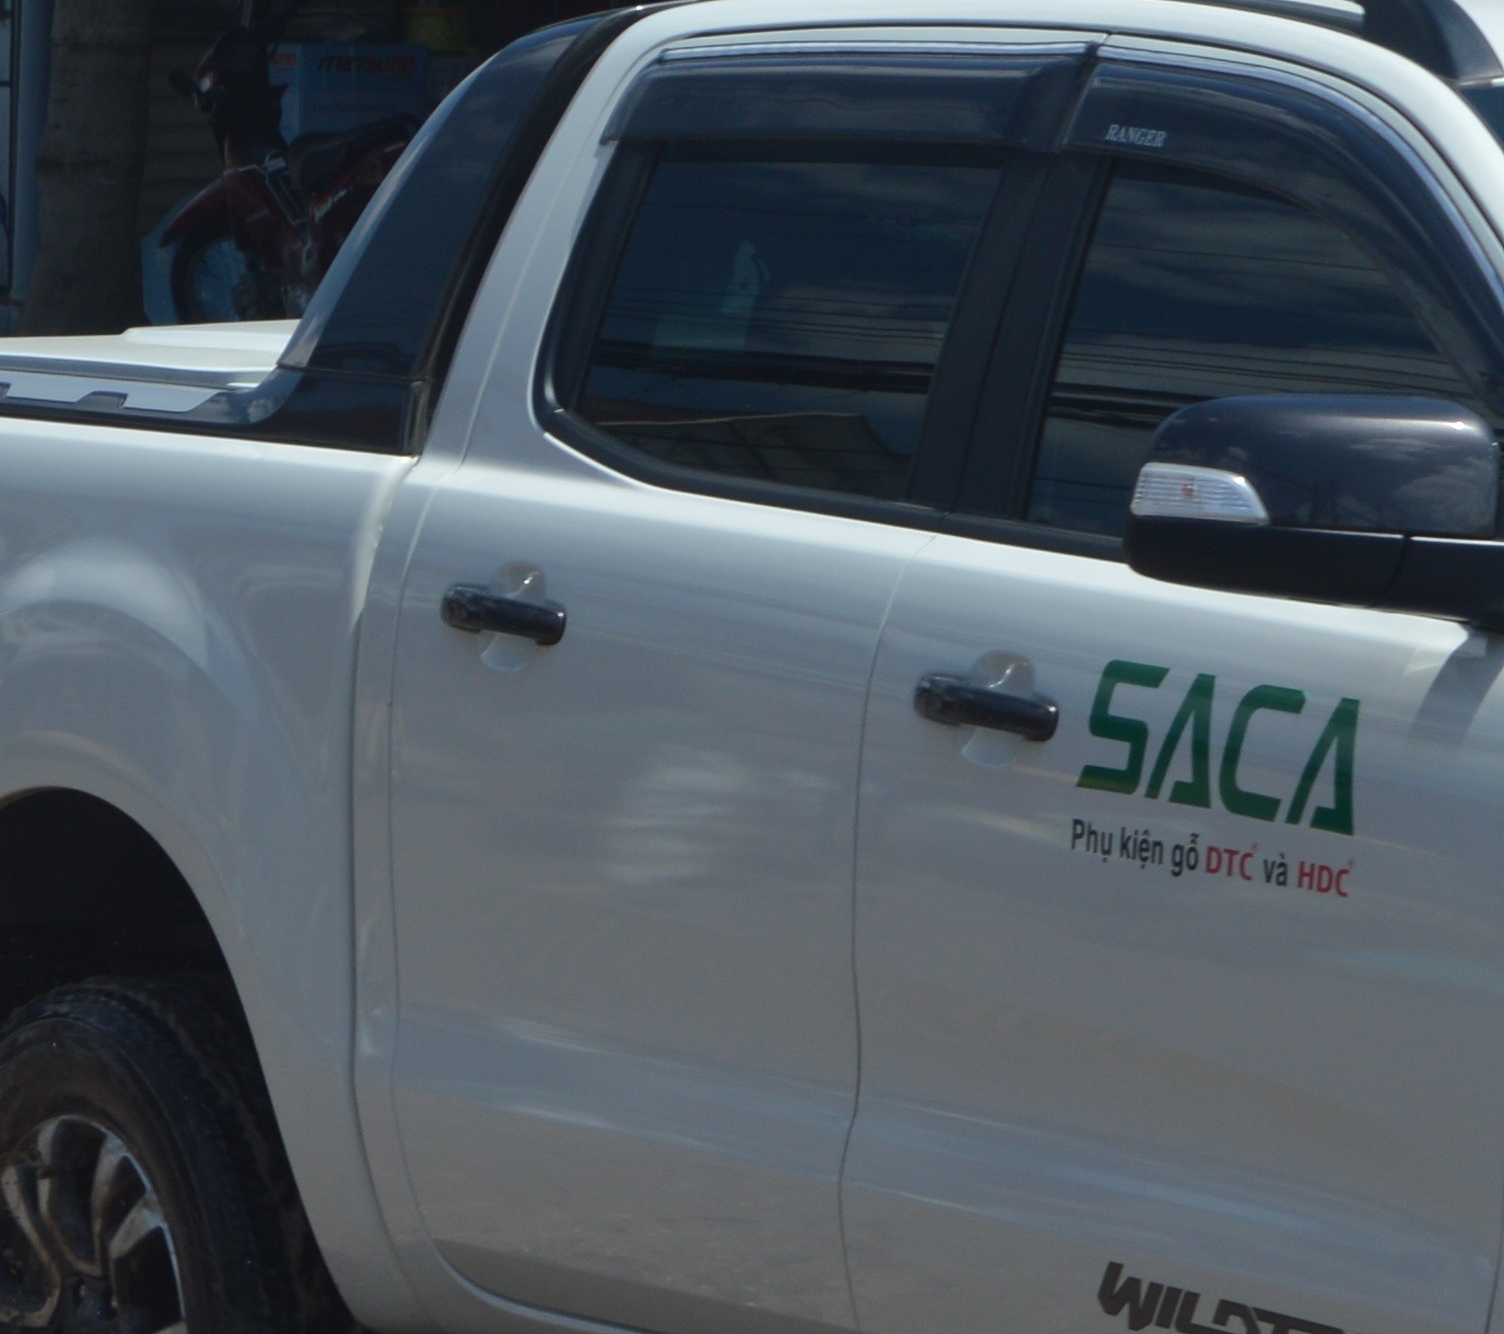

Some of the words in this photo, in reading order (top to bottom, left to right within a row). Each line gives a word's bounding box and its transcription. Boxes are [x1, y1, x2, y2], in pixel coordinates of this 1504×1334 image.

[1075, 658, 1361, 837] SACA
[1070, 818, 1114, 864] Phụ
[1119, 825, 1164, 870] kiện
[1171, 831, 1200, 878] gỗ
[1263, 851, 1288, 887] và
